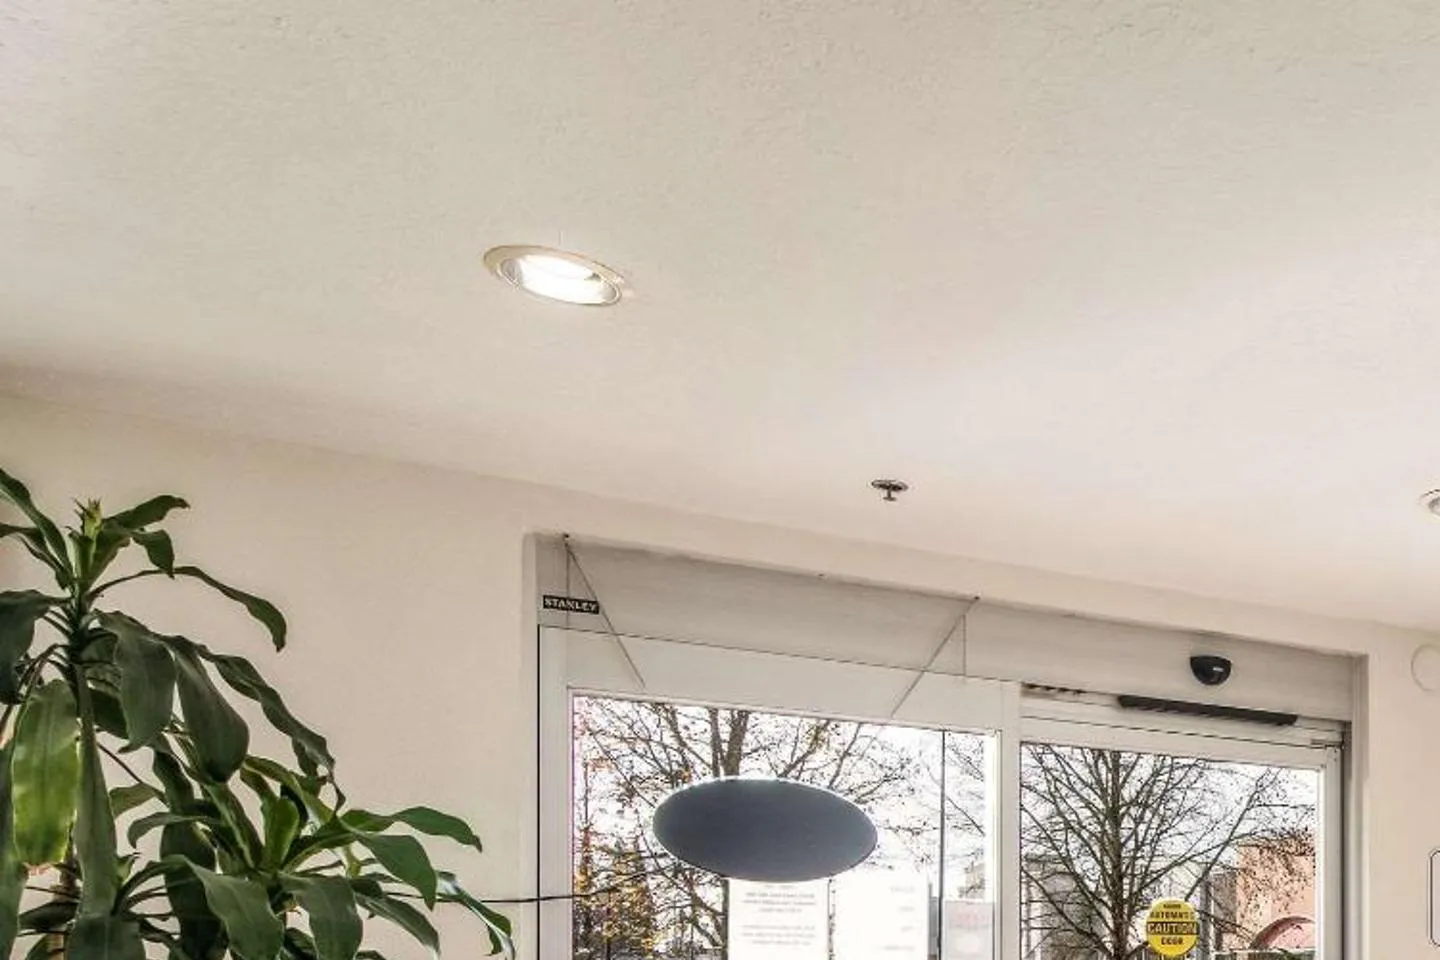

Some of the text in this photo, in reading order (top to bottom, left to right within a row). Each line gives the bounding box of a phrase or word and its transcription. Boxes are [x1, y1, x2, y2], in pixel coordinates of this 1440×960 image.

[544, 598, 597, 612] STANLEY
[1147, 922, 1197, 934] CAUTION
[1161, 936, 1184, 945] DOOR
